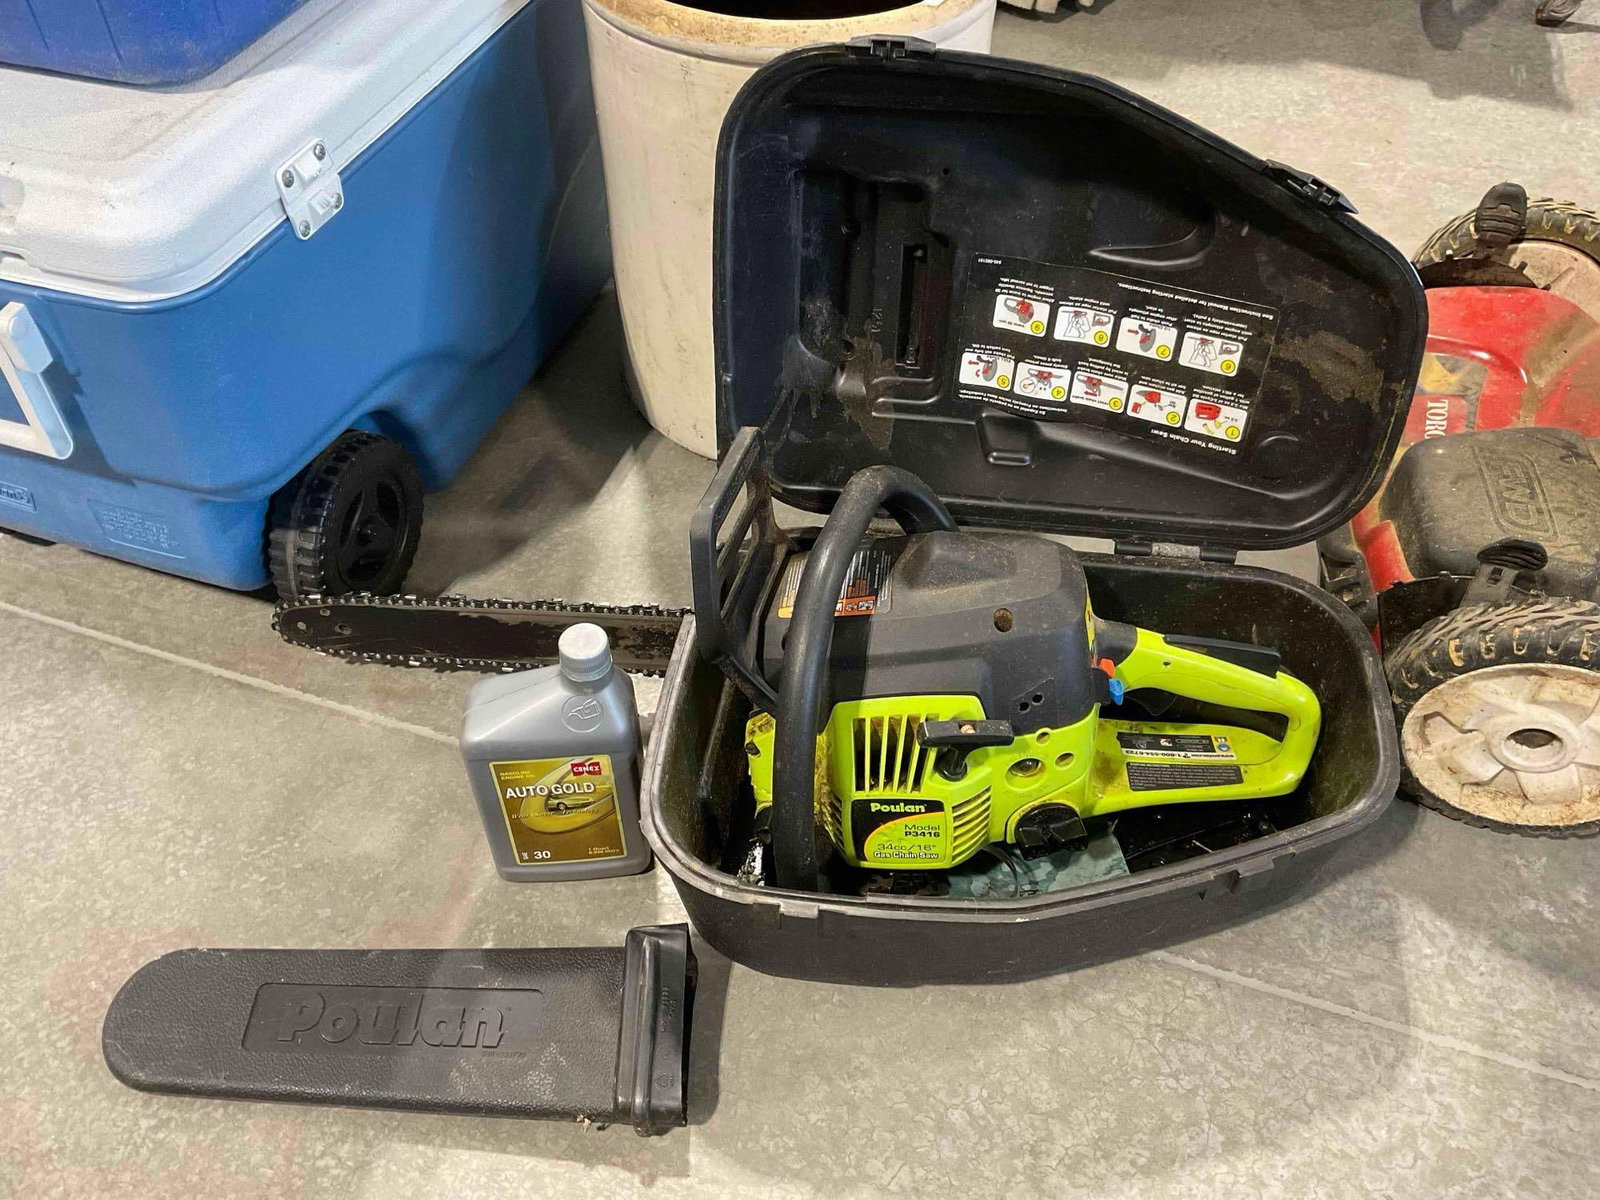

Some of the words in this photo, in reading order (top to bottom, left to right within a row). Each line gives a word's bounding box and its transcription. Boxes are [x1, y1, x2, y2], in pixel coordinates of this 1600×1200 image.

[1117, 282, 1151, 294] instructions.
[1152, 289, 1174, 298] starting
[1175, 295, 1198, 304] detailed
[1208, 302, 1228, 310] Manual
[1229, 307, 1261, 318] Instruction
[1170, 434, 1189, 443] Chain
[1190, 439, 1206, 448] Your
[1208, 442, 1236, 455] Starting
[506, 786, 548, 798] AUTO
[551, 782, 594, 795] GOLD
[870, 803, 926, 812] Poulan
[534, 851, 551, 859] 30
[277, 992, 504, 1048] Poulan
